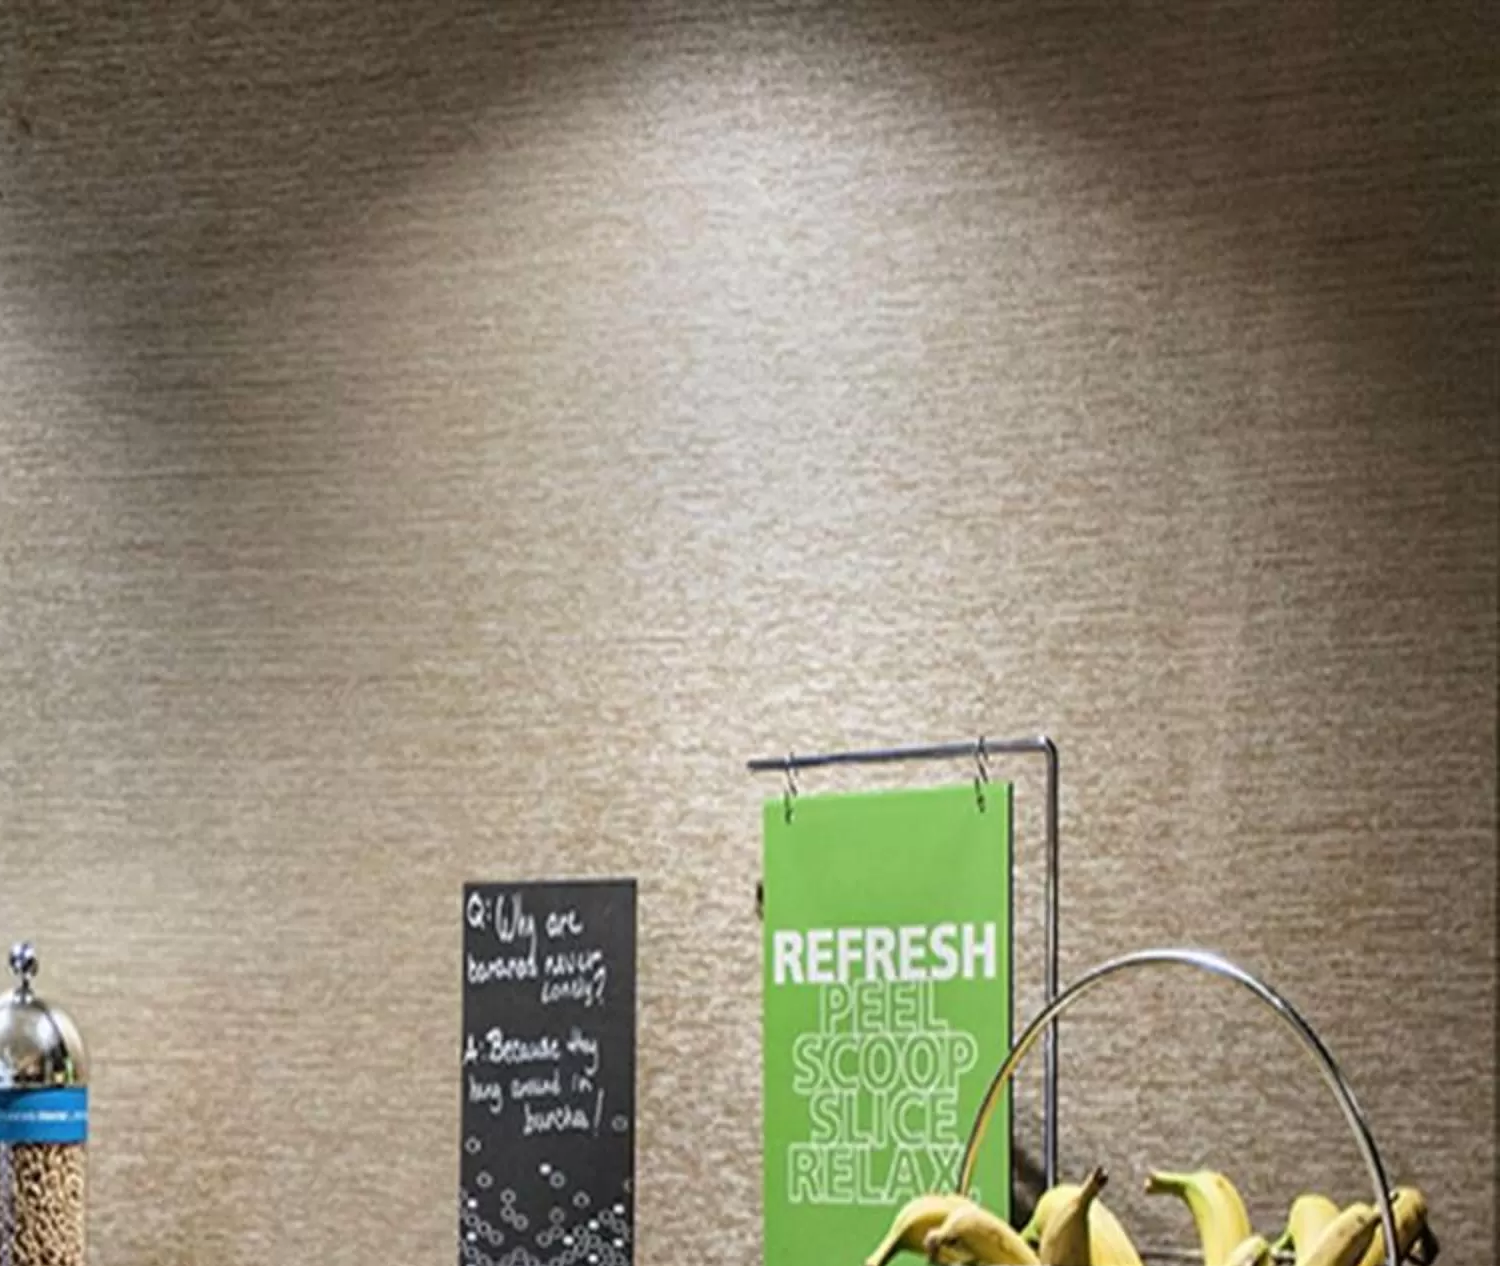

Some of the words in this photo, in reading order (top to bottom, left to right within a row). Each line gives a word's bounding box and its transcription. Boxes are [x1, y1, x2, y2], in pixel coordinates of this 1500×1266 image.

[773, 921, 997, 985] REFRESH
[819, 980, 950, 1035] PEEL
[792, 1031, 979, 1094] SCOOP
[809, 1086, 960, 1147] SLICE
